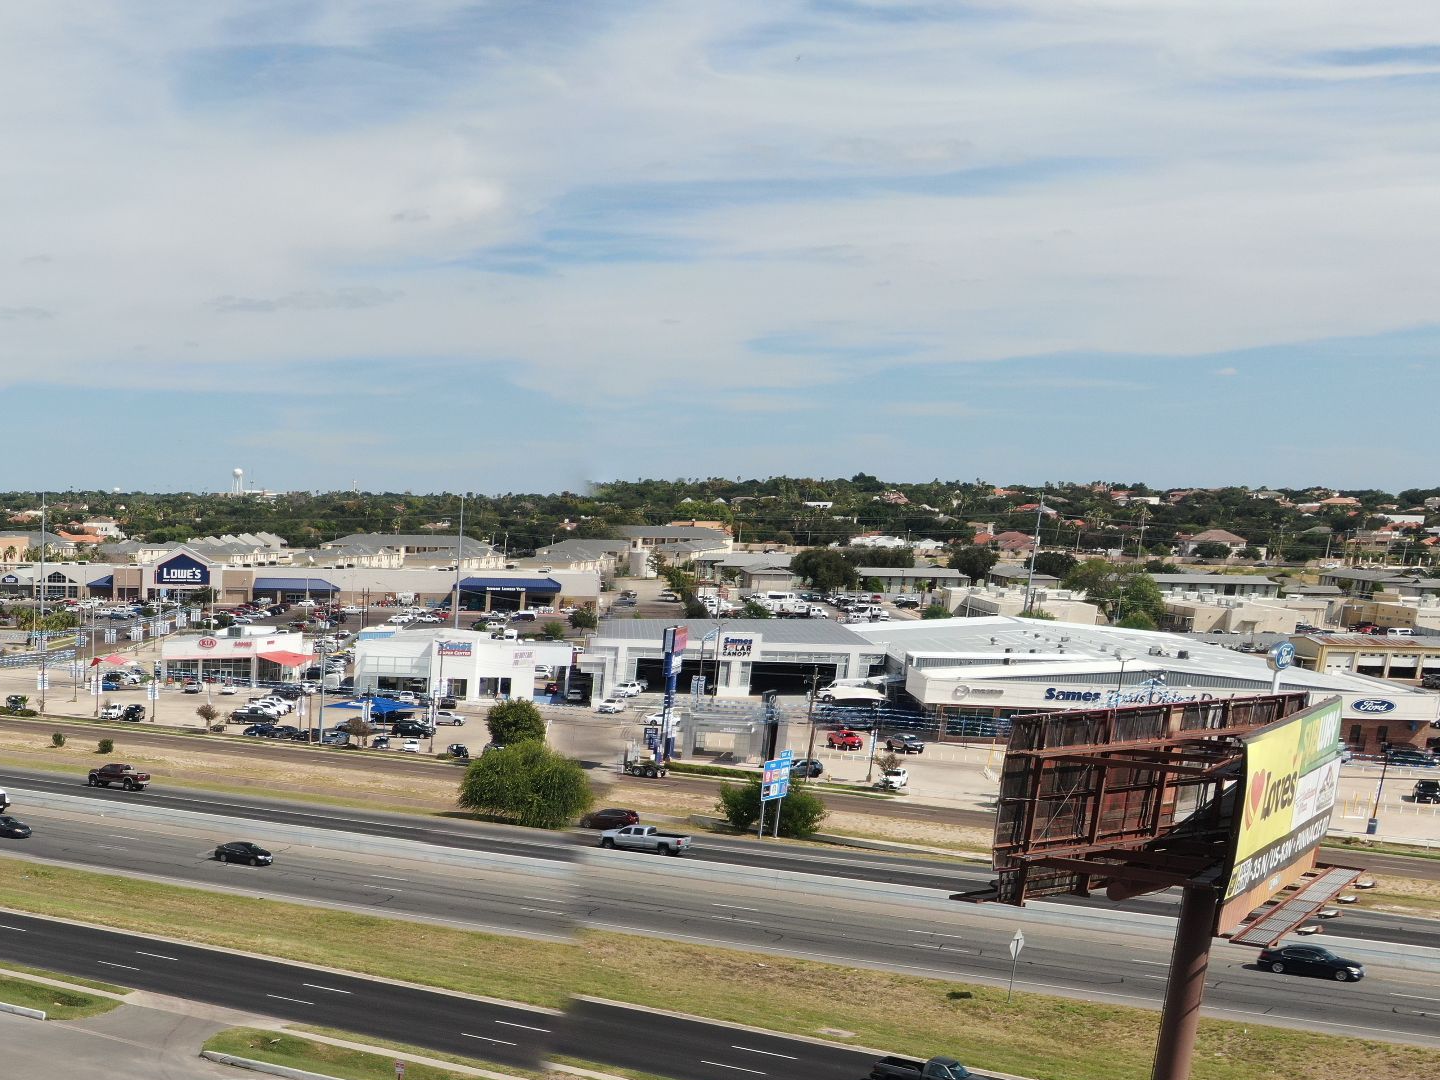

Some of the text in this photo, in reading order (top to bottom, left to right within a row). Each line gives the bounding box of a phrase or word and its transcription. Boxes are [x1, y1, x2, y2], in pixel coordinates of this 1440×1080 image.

[163, 568, 201, 579] LOWE'S
[724, 637, 753, 645] Sames
[1045, 688, 1102, 702] Sames
[1360, 701, 1388, 711] Ford
